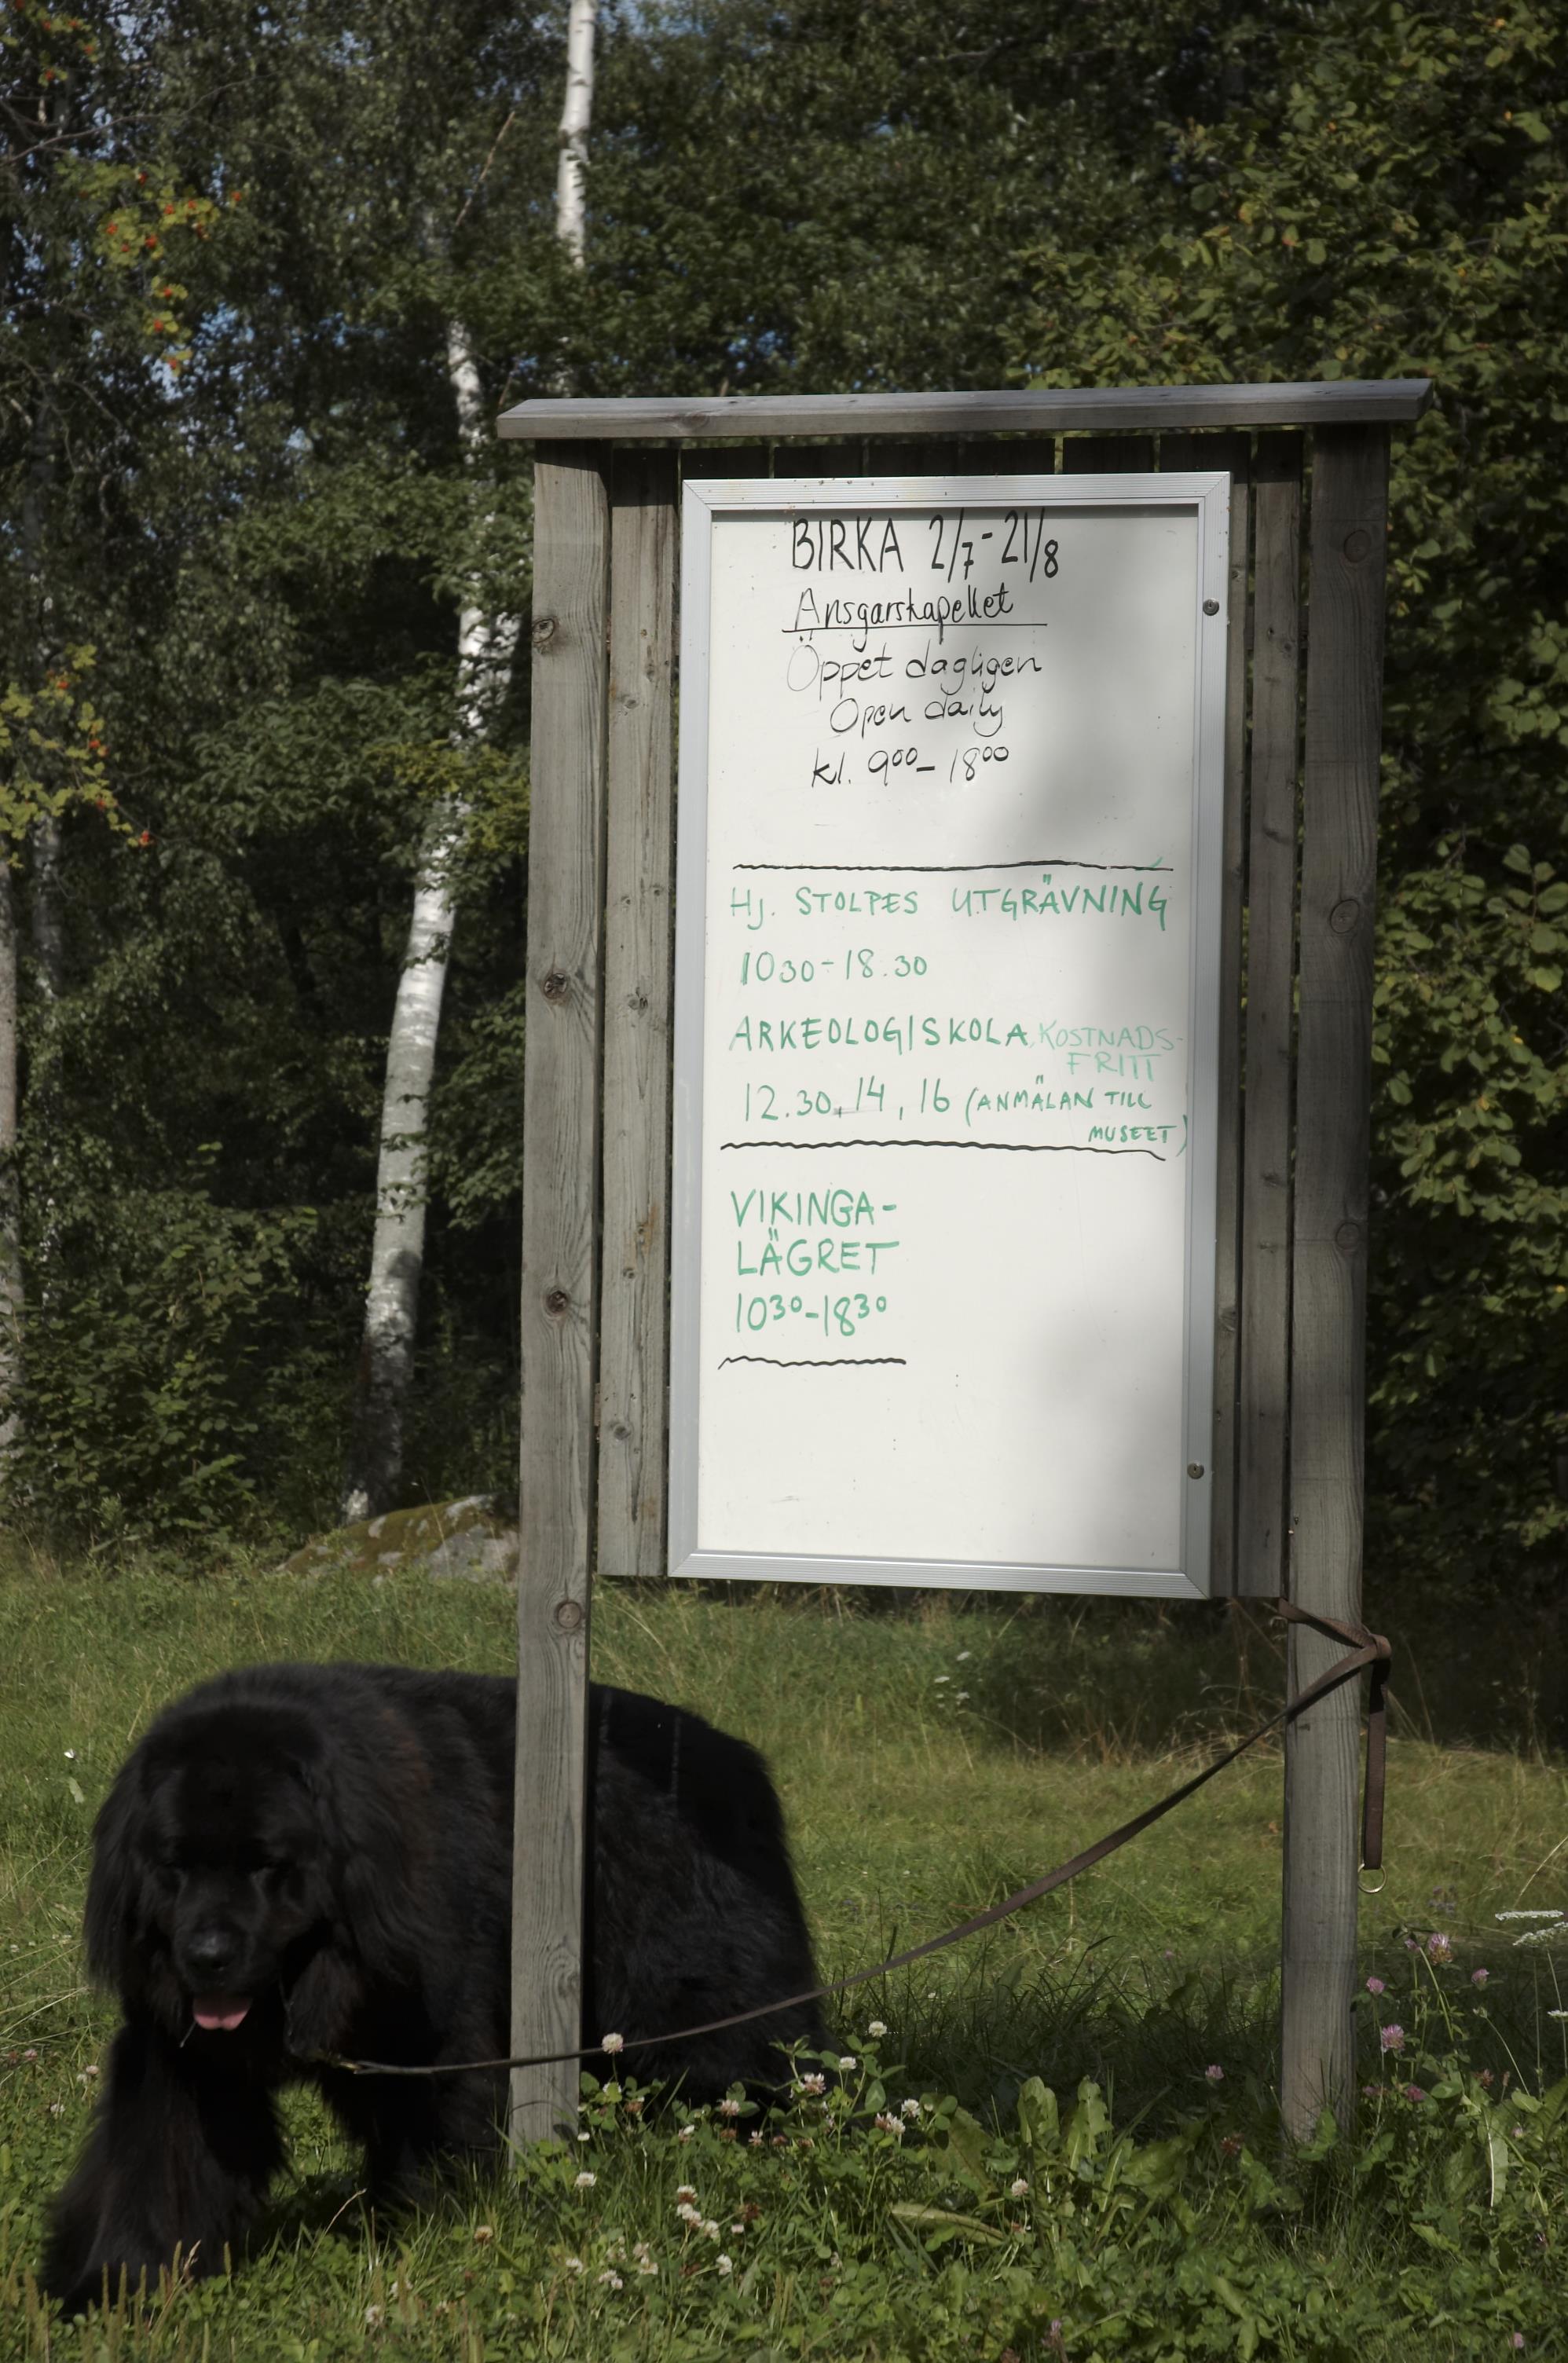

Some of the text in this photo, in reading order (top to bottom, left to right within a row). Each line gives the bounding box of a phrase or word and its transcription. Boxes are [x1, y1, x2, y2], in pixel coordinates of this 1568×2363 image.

[791, 515, 905, 573] BIRKA
[793, 581, 1015, 654] Ansgarskapellet
[786, 635, 1042, 702] Öppet dagligen
[830, 691, 1003, 738] Open daily
[795, 886, 920, 916] STOLPES
[951, 873, 1168, 932] UTGRÄVNING
[1066, 1051, 1163, 1083] FRITT
[920, 1077, 951, 1113] 16
[965, 1074, 1094, 1127] (ANMÄLAN
[1104, 1090, 1152, 1110] TILL
[1088, 1113, 1189, 1158] MUSEET)
[731, 1188, 898, 1228] VIKINGA-
[737, 1227, 900, 1277] LÄGRET
